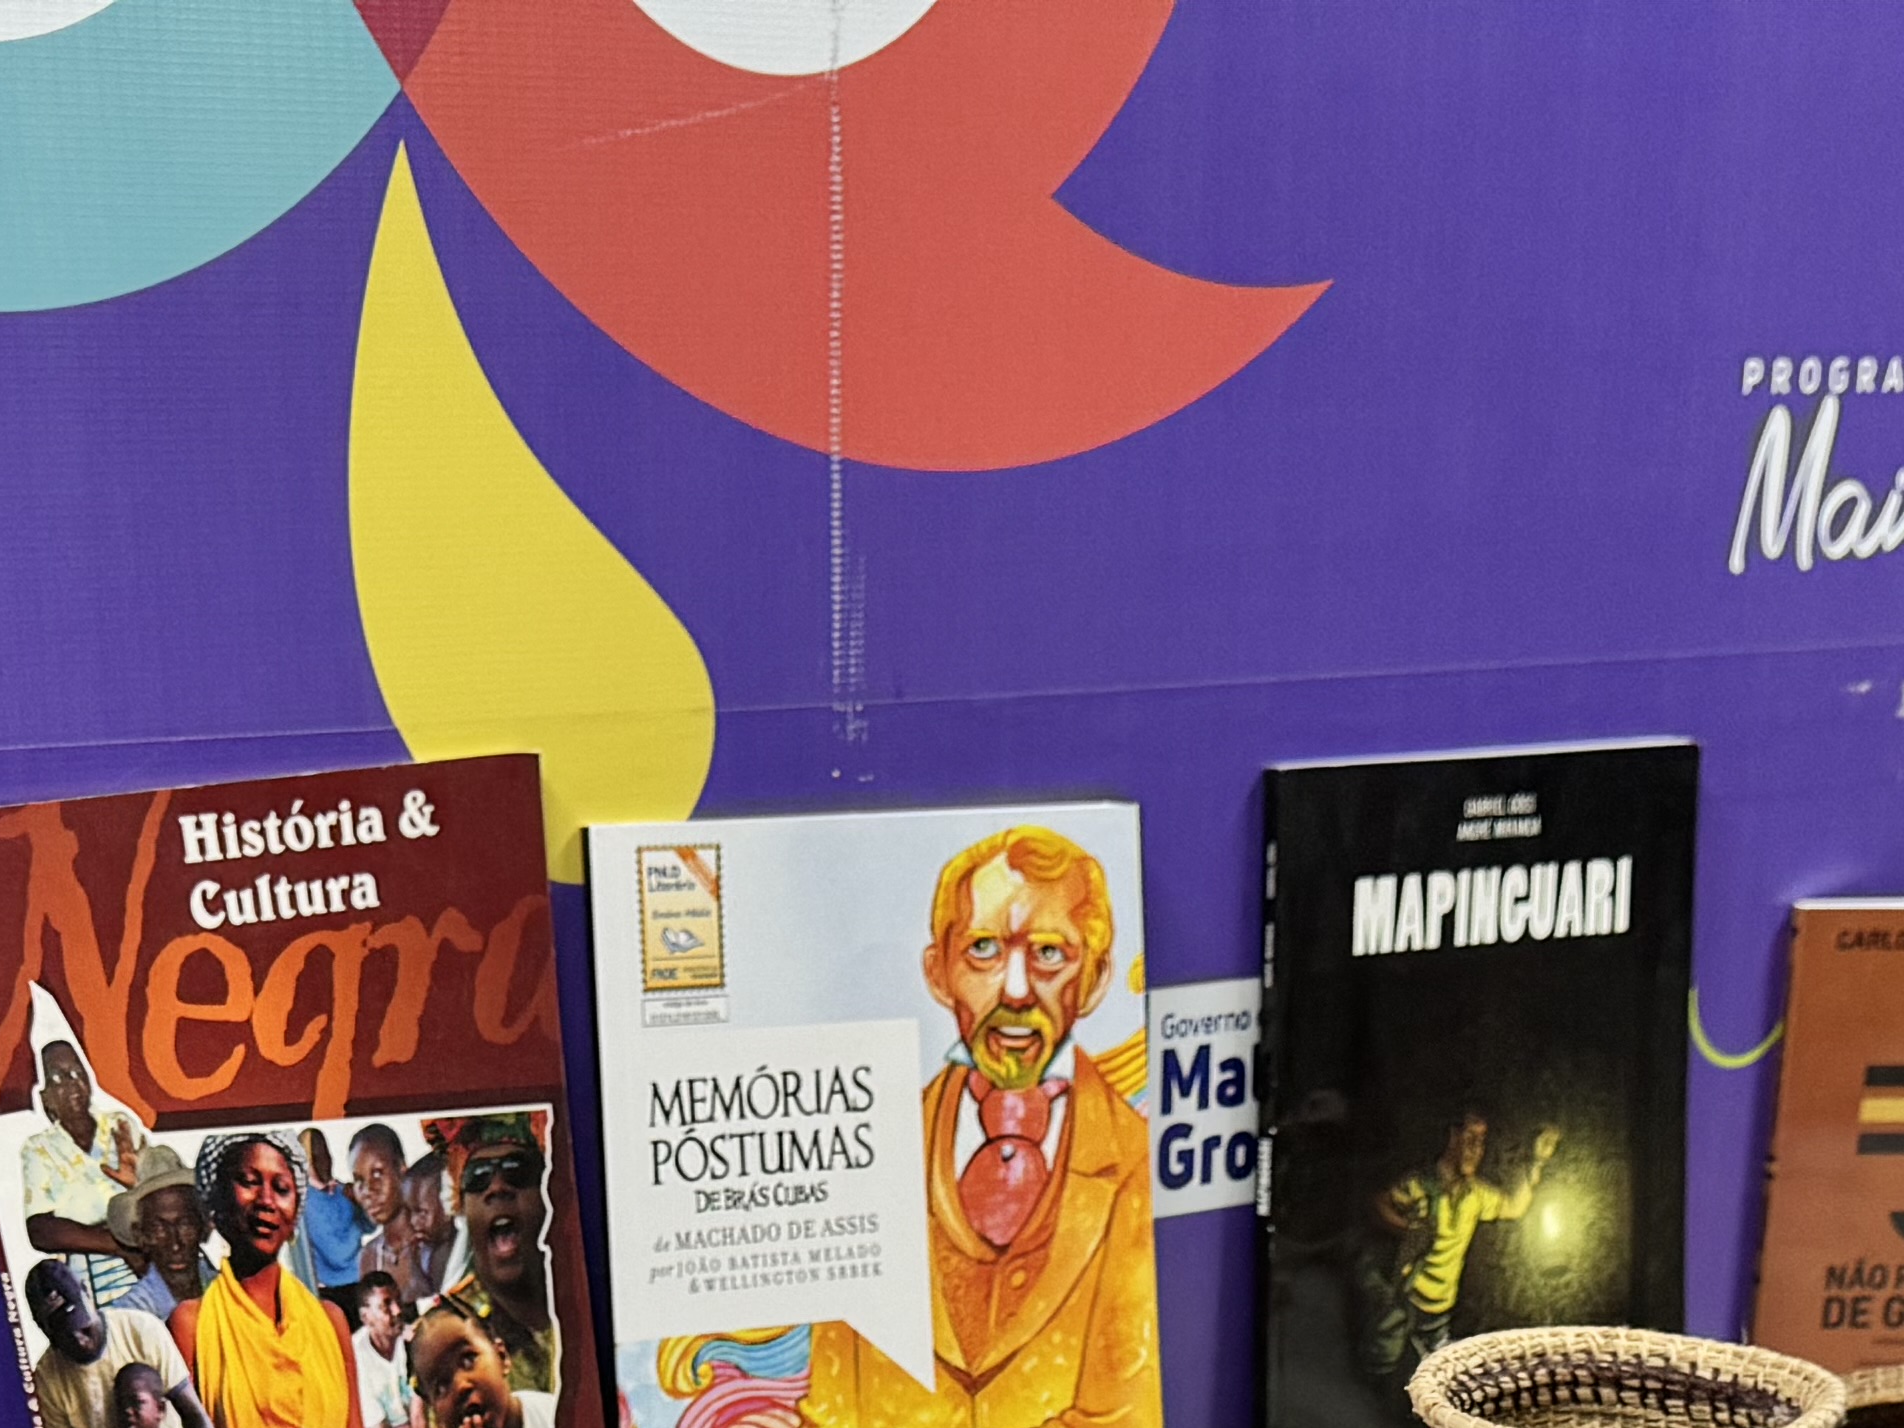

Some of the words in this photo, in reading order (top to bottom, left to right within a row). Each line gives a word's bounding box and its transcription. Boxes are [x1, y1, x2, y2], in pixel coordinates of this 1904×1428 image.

[178, 799, 386, 864] História
[398, 789, 439, 839] &
[190, 872, 380, 930] Cultura
[1352, 854, 1633, 957] MAPINGUARI
[1161, 1009, 1251, 1039] Governo
[649, 1064, 874, 1128] MEMÓRIAS
[650, 1122, 874, 1186] PÓSTUMAS
[694, 1189, 722, 1214] DE
[724, 1181, 770, 1212] BRÁS
[772, 1180, 828, 1207] CUBAS
[674, 1222, 782, 1251] MACHADO
[787, 1219, 817, 1240] DE
[820, 1213, 880, 1237] ASSIS
[677, 1255, 722, 1278] JOÃO
[728, 1249, 802, 1271] BATISTA
[808, 1243, 882, 1263] MELADO
[1825, 1256, 1888, 1290] NÃO
[702, 1268, 821, 1292] WELLINGTON
[1821, 1295, 1872, 1330] DE
